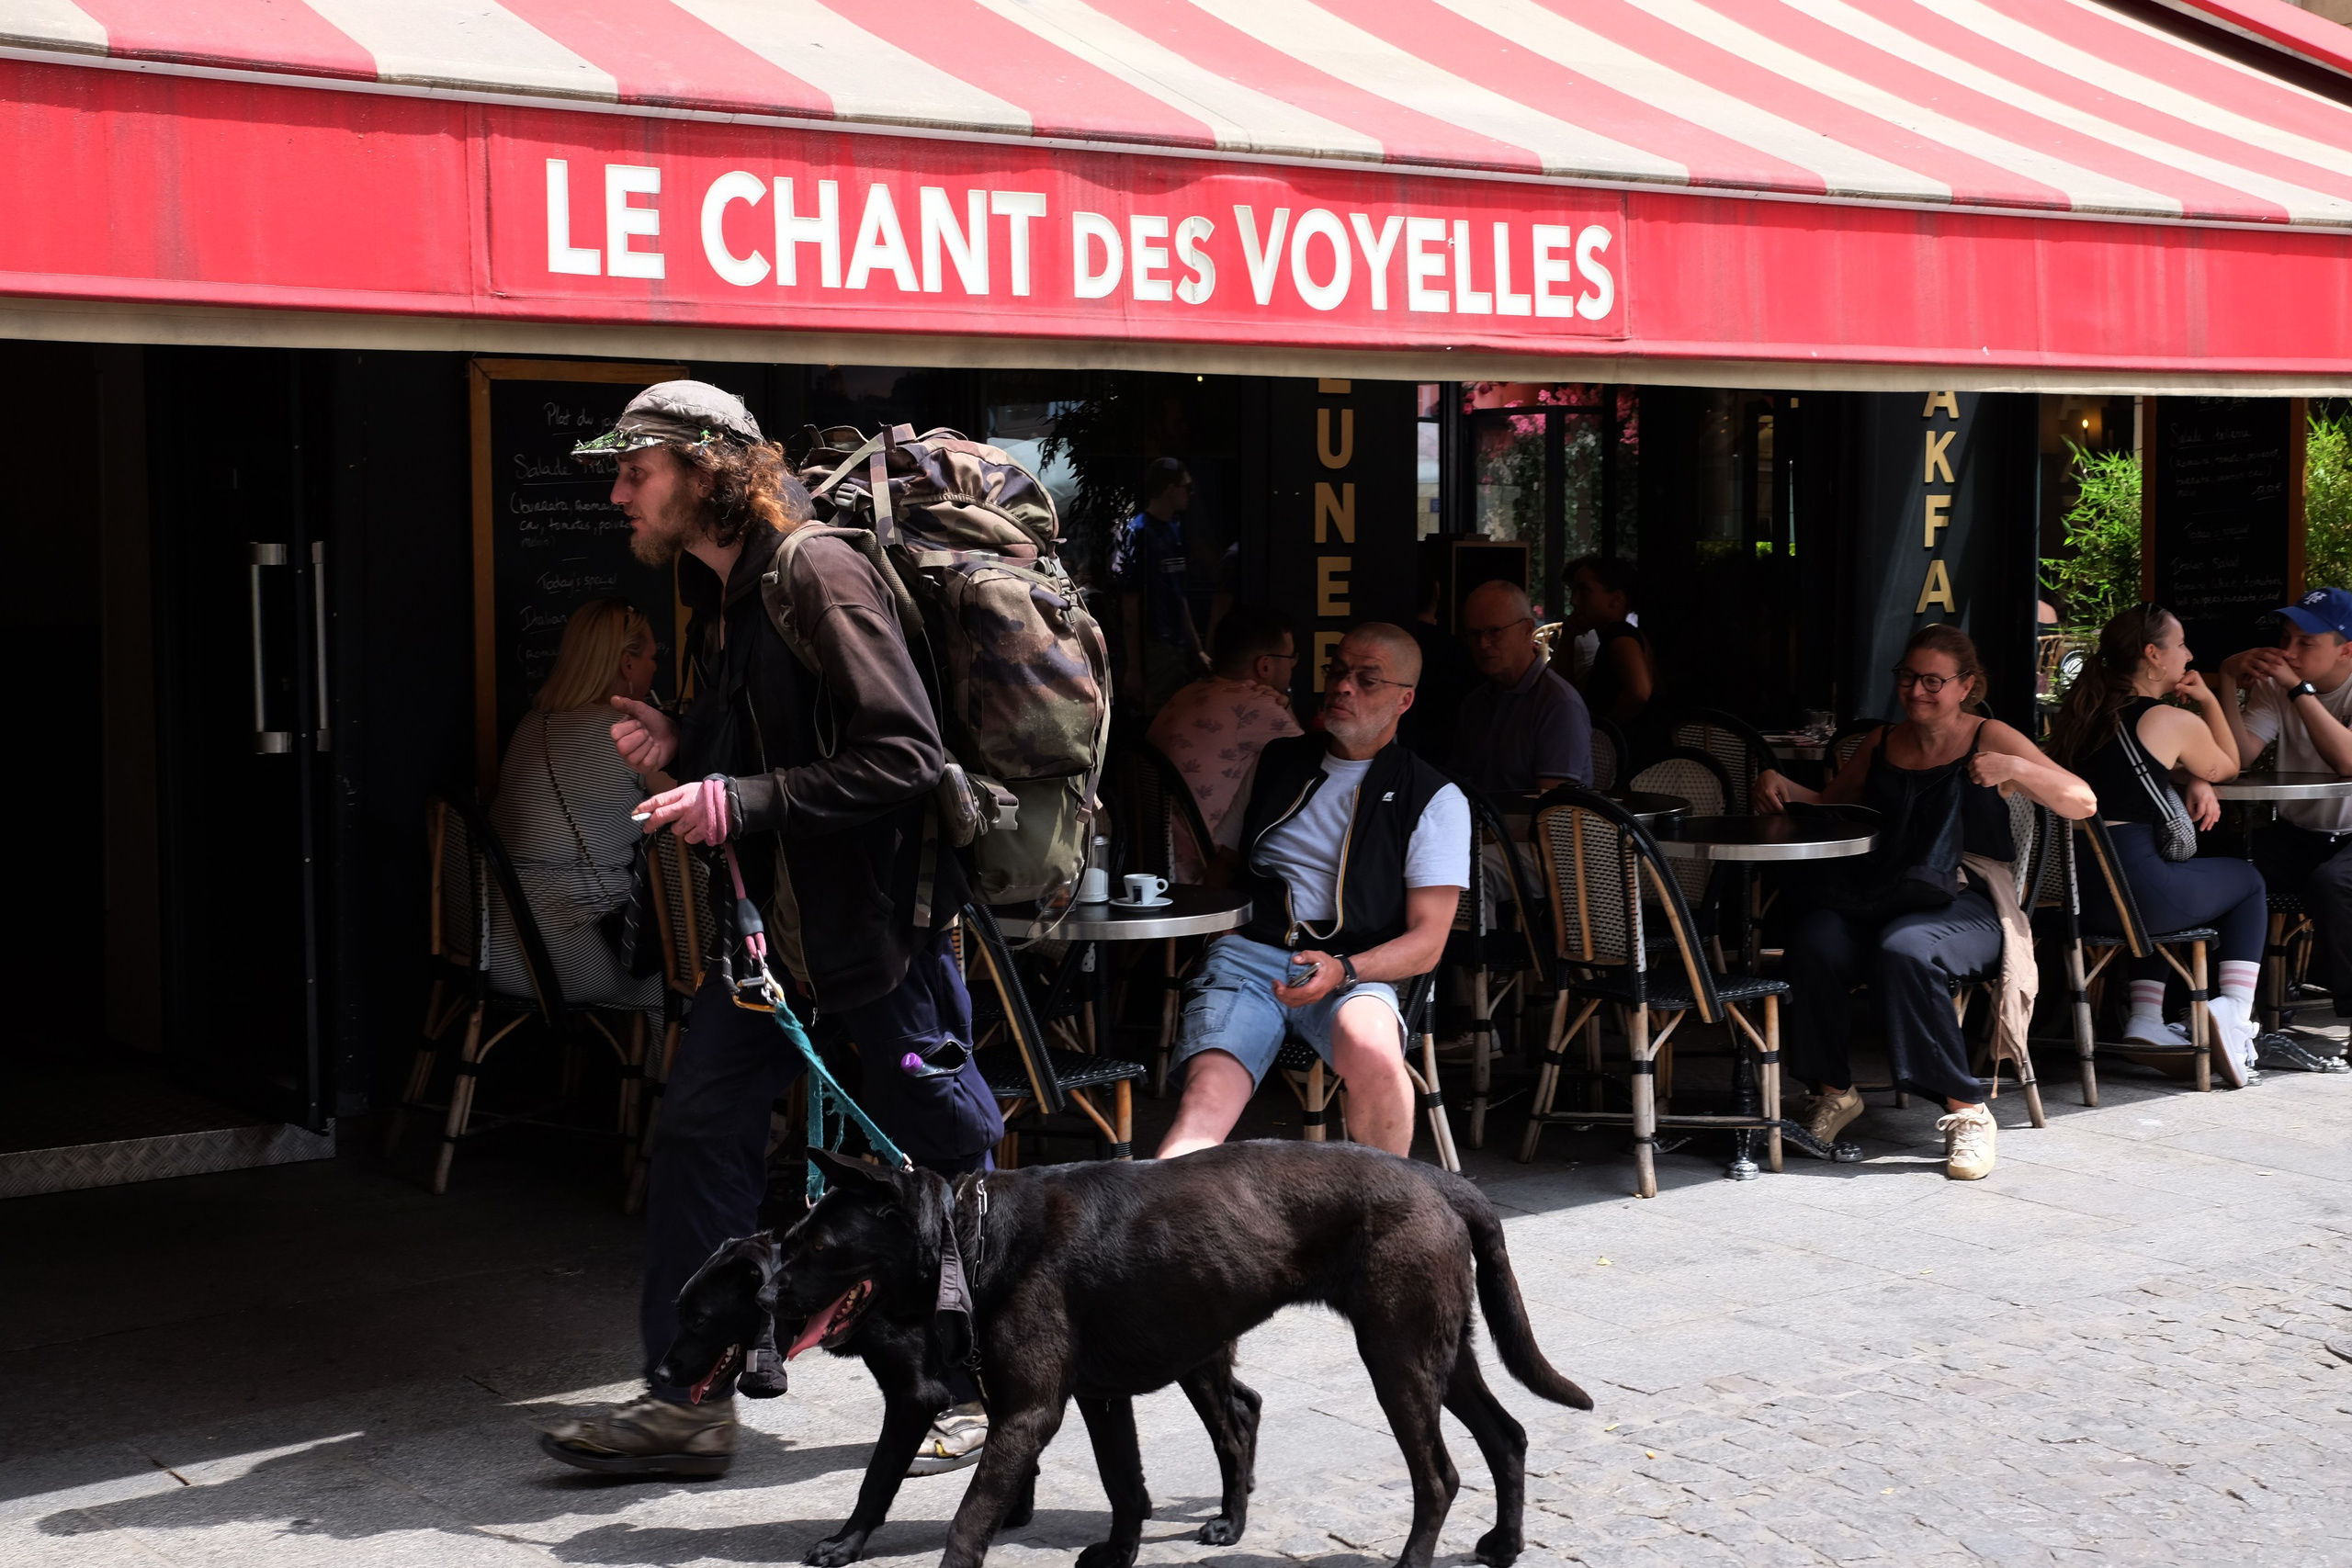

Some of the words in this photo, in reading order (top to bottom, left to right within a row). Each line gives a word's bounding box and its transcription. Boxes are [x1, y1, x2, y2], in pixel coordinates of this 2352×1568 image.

[546, 158, 665, 279] LE
[700, 171, 1047, 297] CHANT
[1072, 211, 1217, 305] DES
[1233, 205, 1615, 321] VOYELLES
[577, 408, 594, 425] du
[514, 454, 573, 479] Salade
[536, 571, 581, 599] Today's
